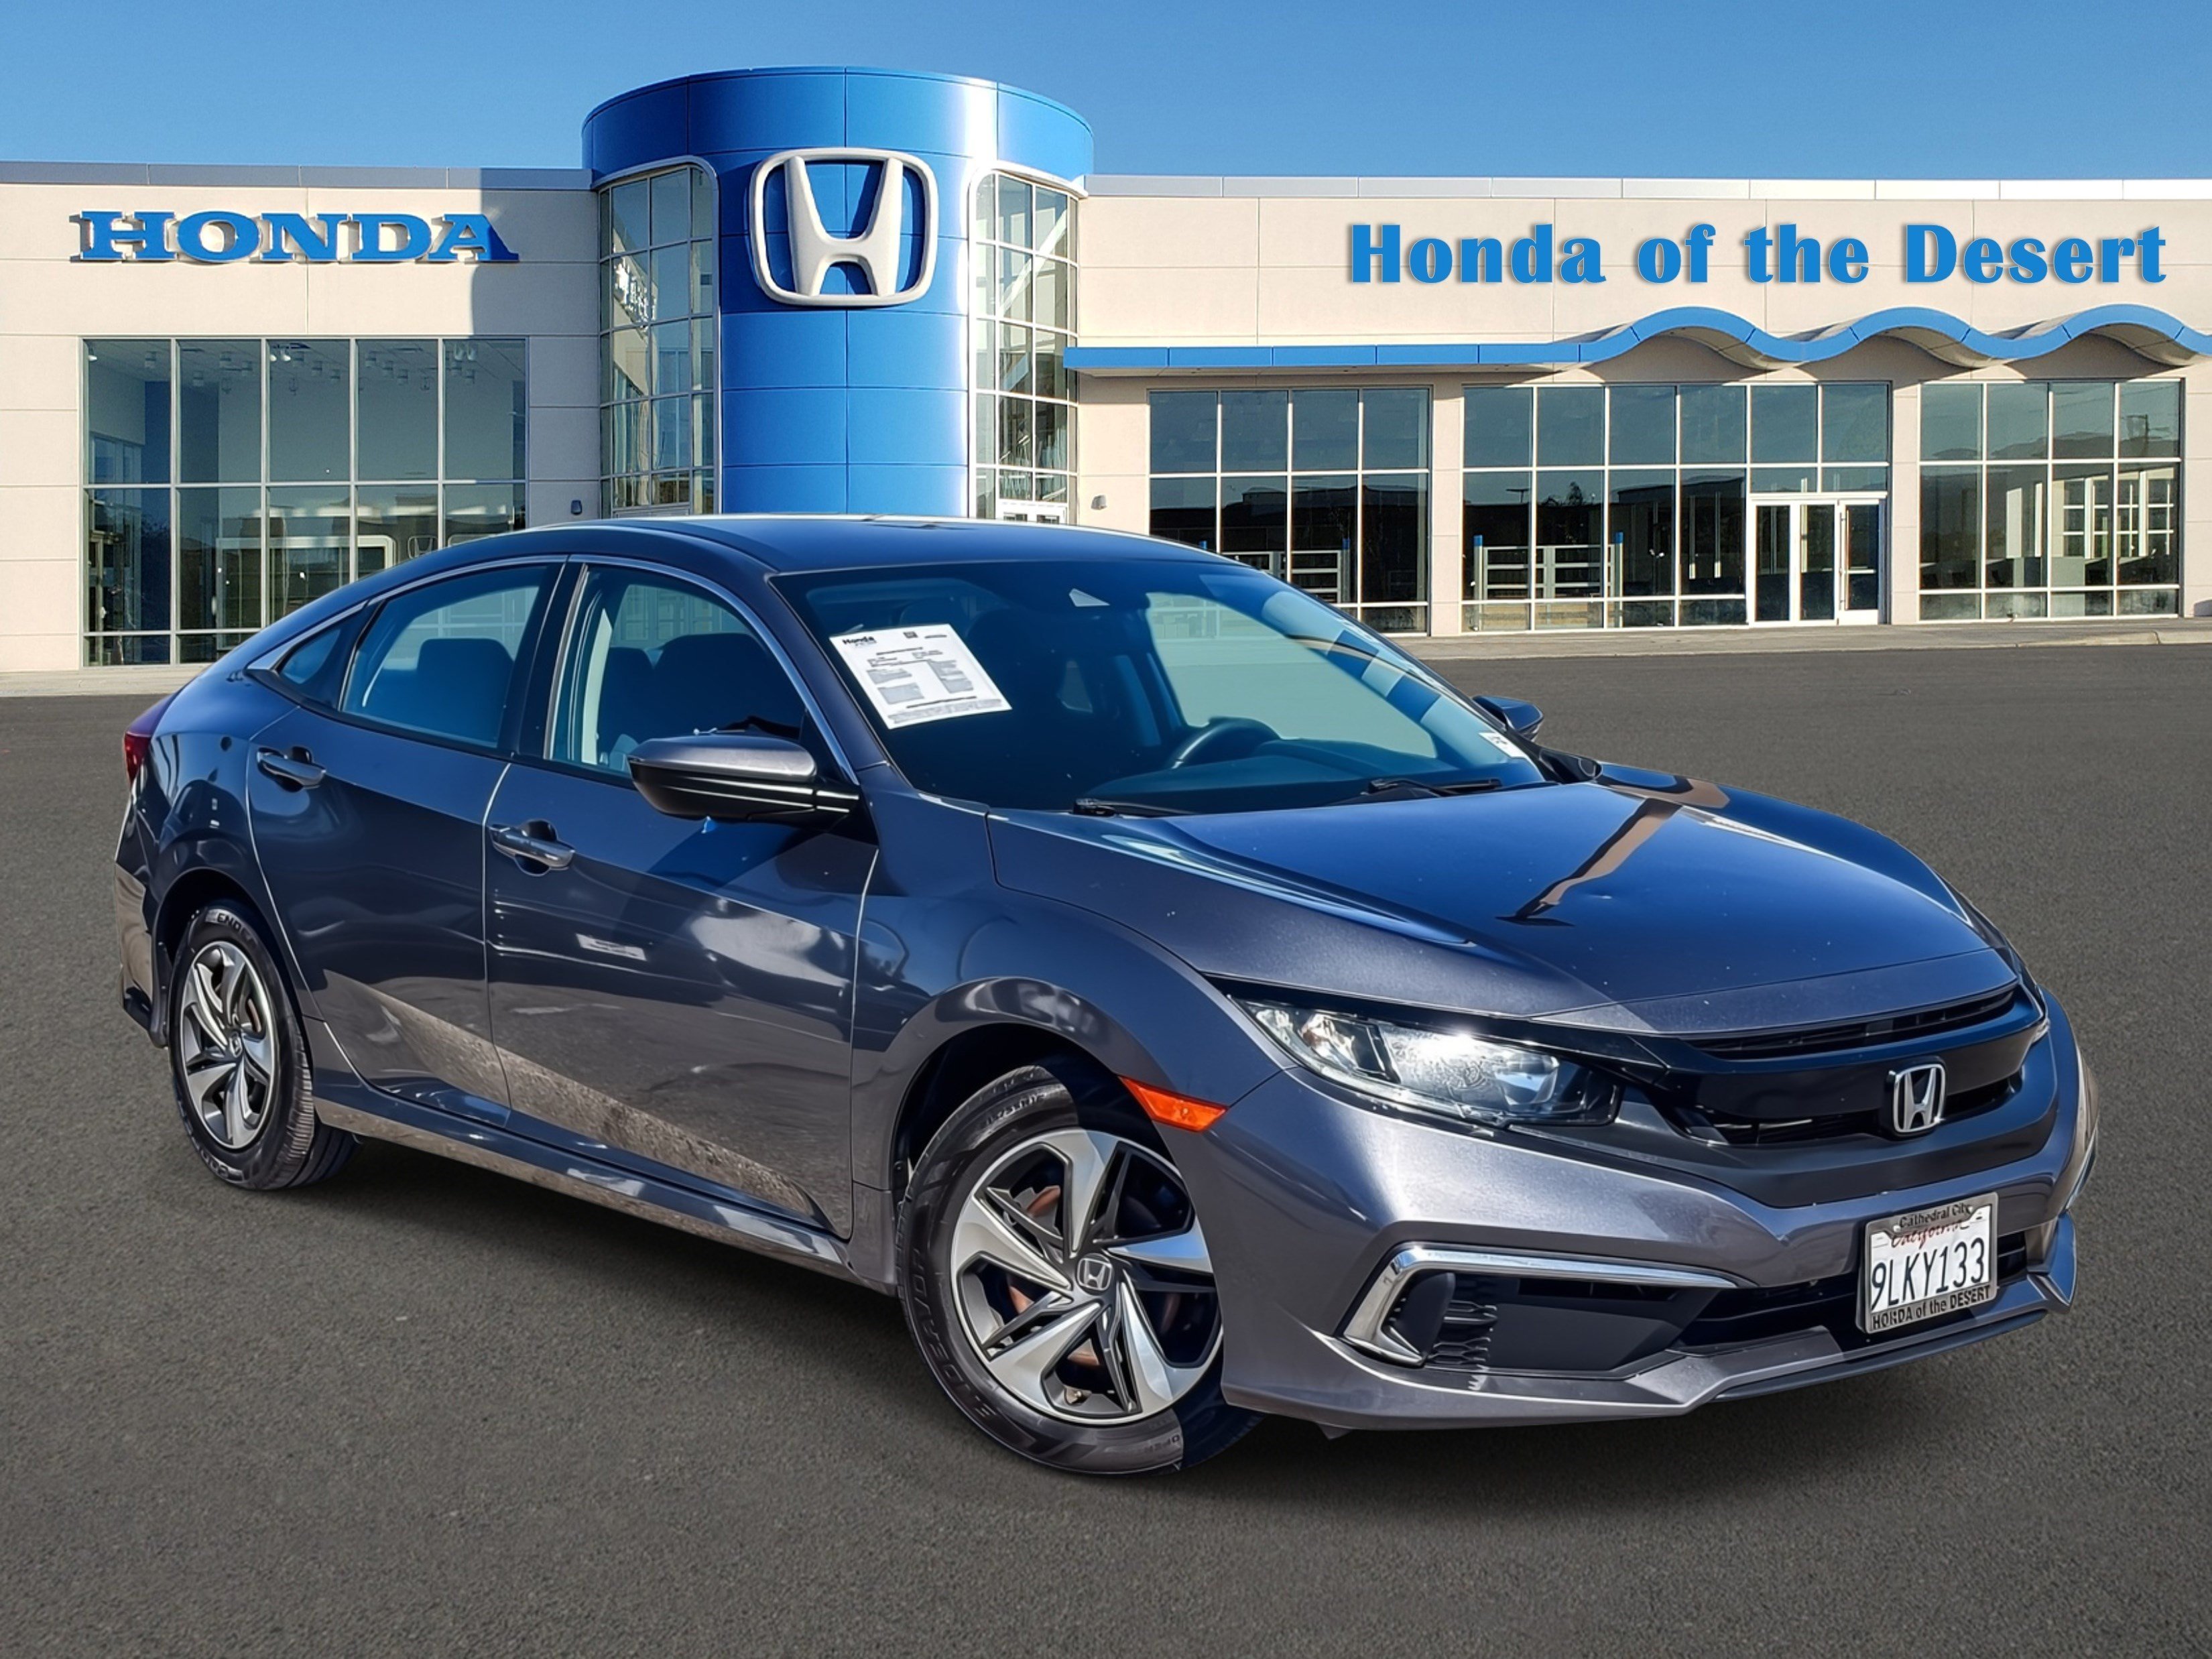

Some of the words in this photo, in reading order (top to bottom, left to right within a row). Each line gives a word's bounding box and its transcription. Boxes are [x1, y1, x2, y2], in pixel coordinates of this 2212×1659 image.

[78, 210, 519, 263] HONDA
[1350, 223, 1607, 284] Honda
[1637, 223, 1717, 284] of
[1743, 223, 1869, 284] the
[1906, 224, 2167, 284] Desert
[1899, 1206, 1950, 1229] Cathedral
[1870, 1237, 1985, 1310] 9LKY133
[1872, 1309, 1913, 1331] HONDA
[1916, 1301, 1926, 1318] of
[1930, 1298, 1947, 1314] the
[1949, 1285, 1991, 1309] DESERT
